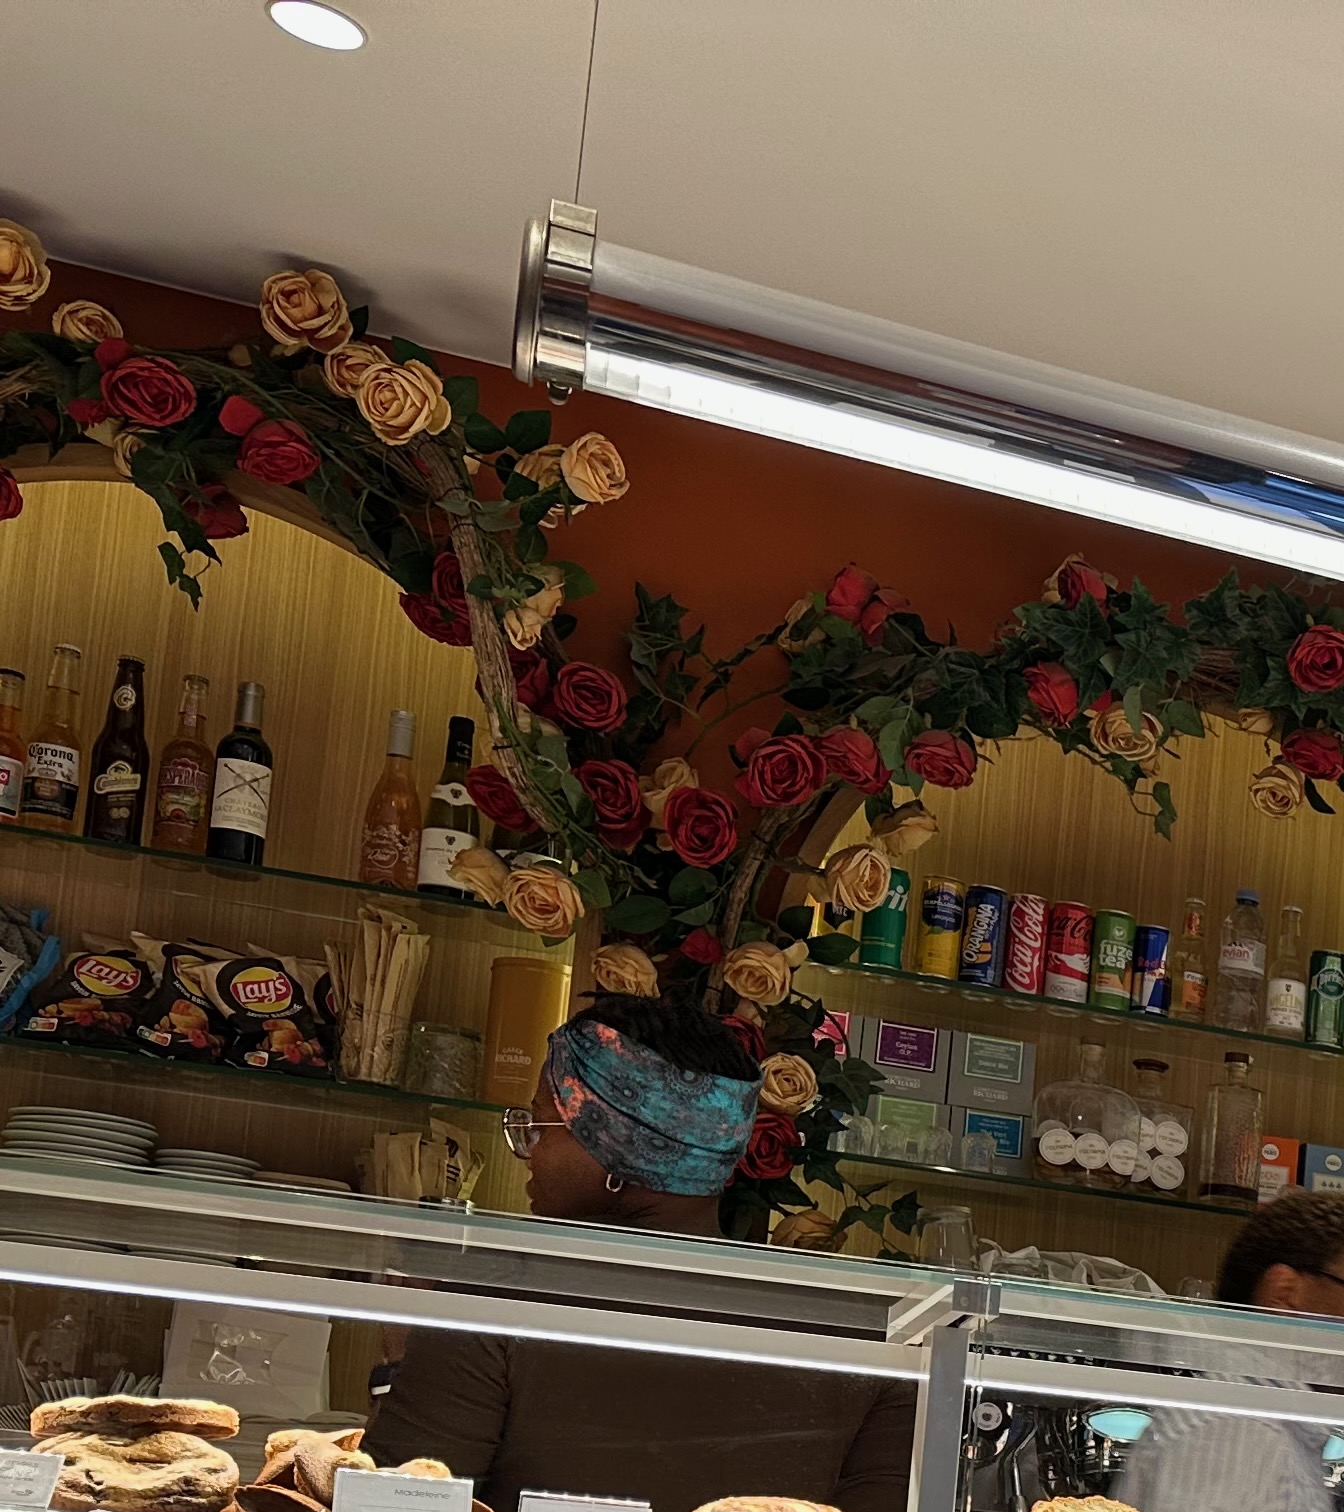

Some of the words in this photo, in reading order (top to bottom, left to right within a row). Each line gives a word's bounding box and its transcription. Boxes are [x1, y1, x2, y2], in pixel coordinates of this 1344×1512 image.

[29, 743, 75, 763] Corona
[36, 755, 63, 769] Extra
[963, 903, 995, 963] ORANGINA
[1100, 940, 1132, 959] fuze
[1223, 949, 1250, 960] evian
[1100, 954, 1126, 970] tea
[80, 959, 136, 987] Lay's
[237, 976, 287, 1004] Lay's
[395, 1488, 450, 1501] Madeleine
